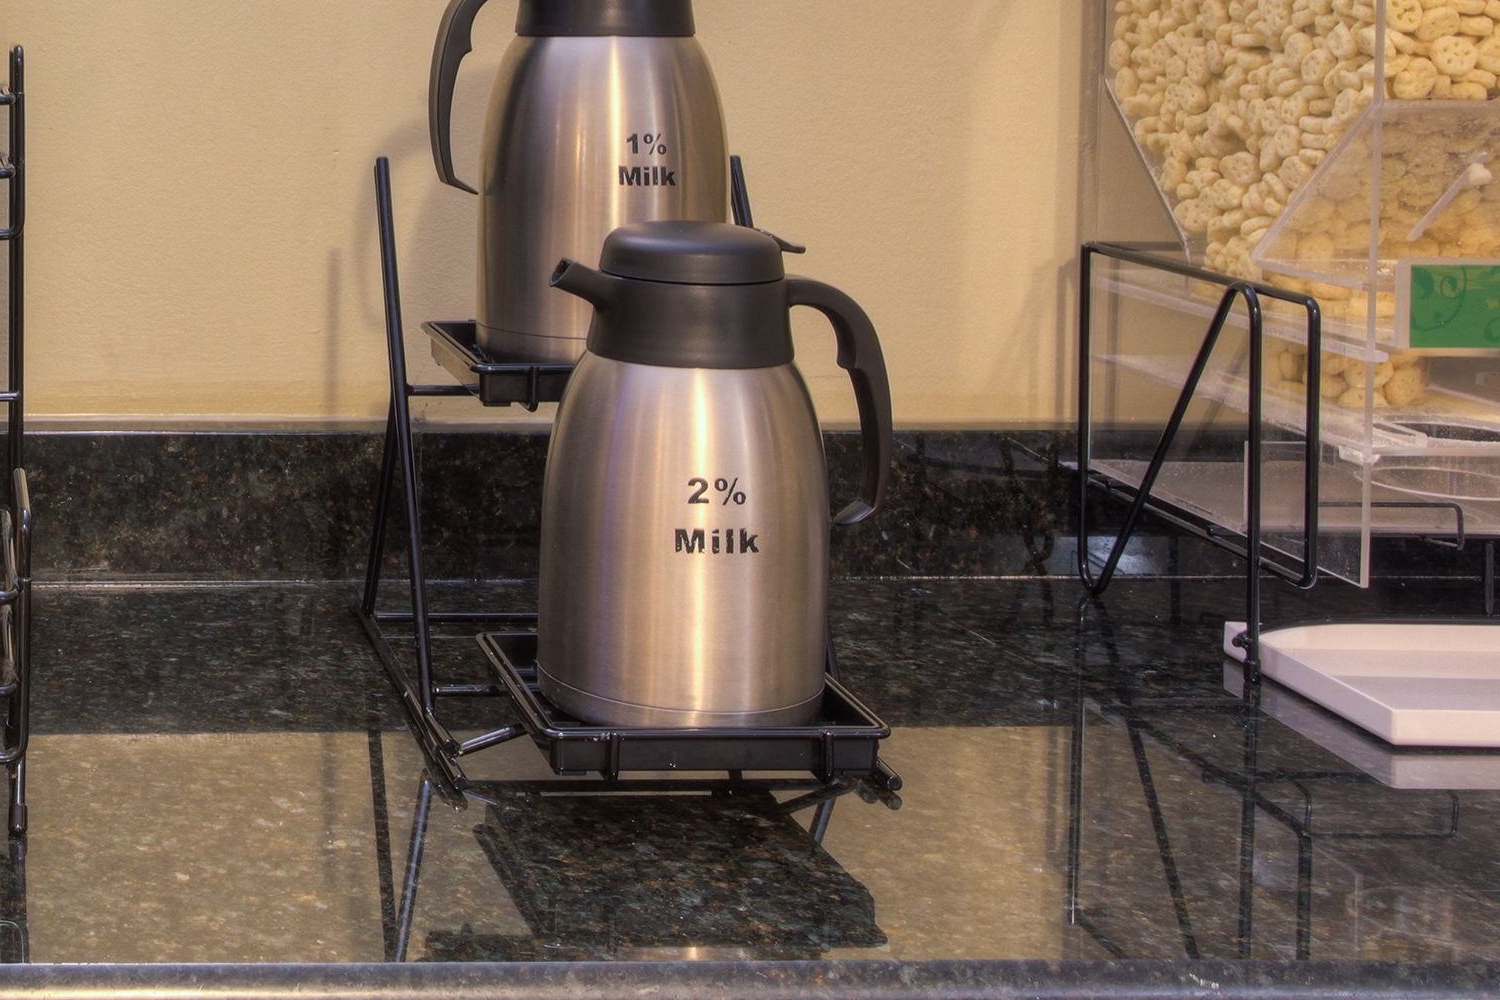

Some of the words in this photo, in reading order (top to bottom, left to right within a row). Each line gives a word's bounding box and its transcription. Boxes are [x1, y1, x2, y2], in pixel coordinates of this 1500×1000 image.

[626, 133, 667, 156] 1%
[618, 165, 676, 186] Milk
[687, 477, 747, 506] 2%
[674, 528, 759, 555] Milk
